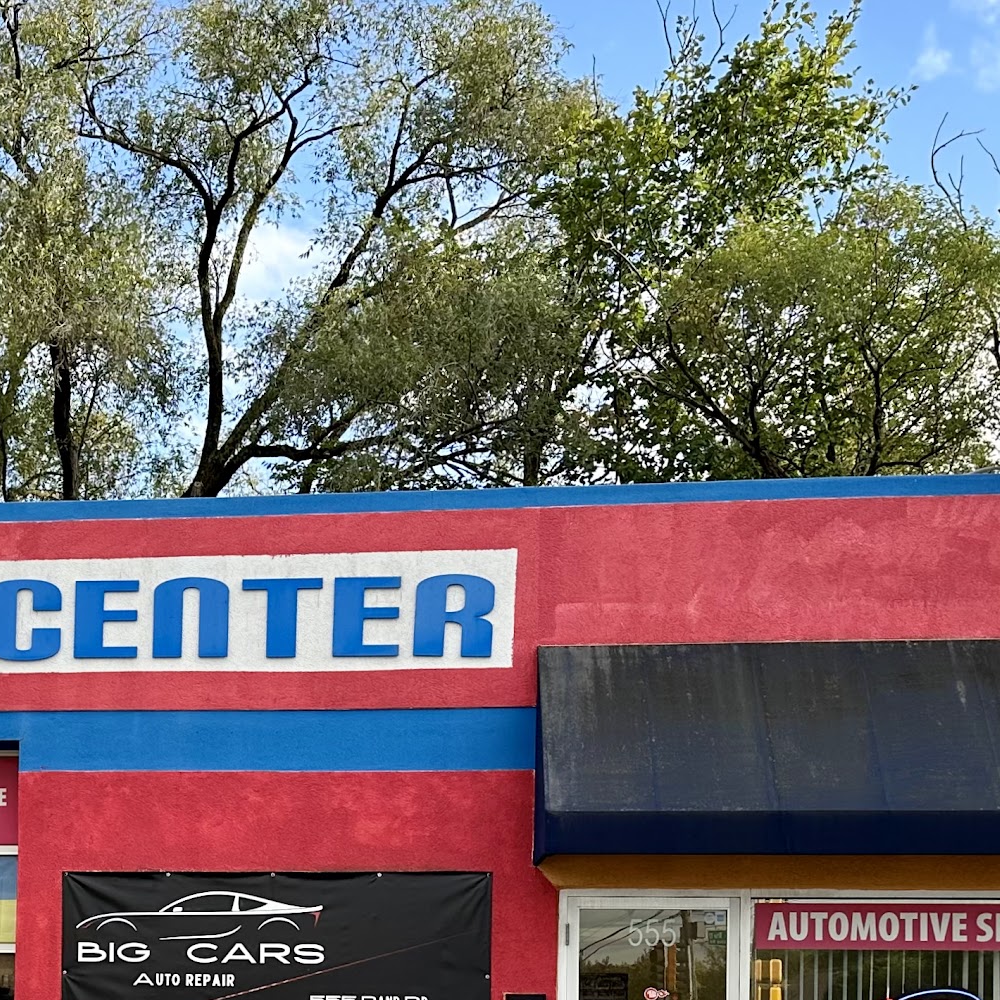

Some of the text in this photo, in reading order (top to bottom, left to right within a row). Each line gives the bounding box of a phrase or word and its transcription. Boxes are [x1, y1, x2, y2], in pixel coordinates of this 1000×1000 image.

[628, 918, 677, 947] 555
[768, 911, 1000, 943] AUTOMOTIVE S
[77, 941, 325, 965] BIG CARS
[185, 973, 235, 987] REPAIR
